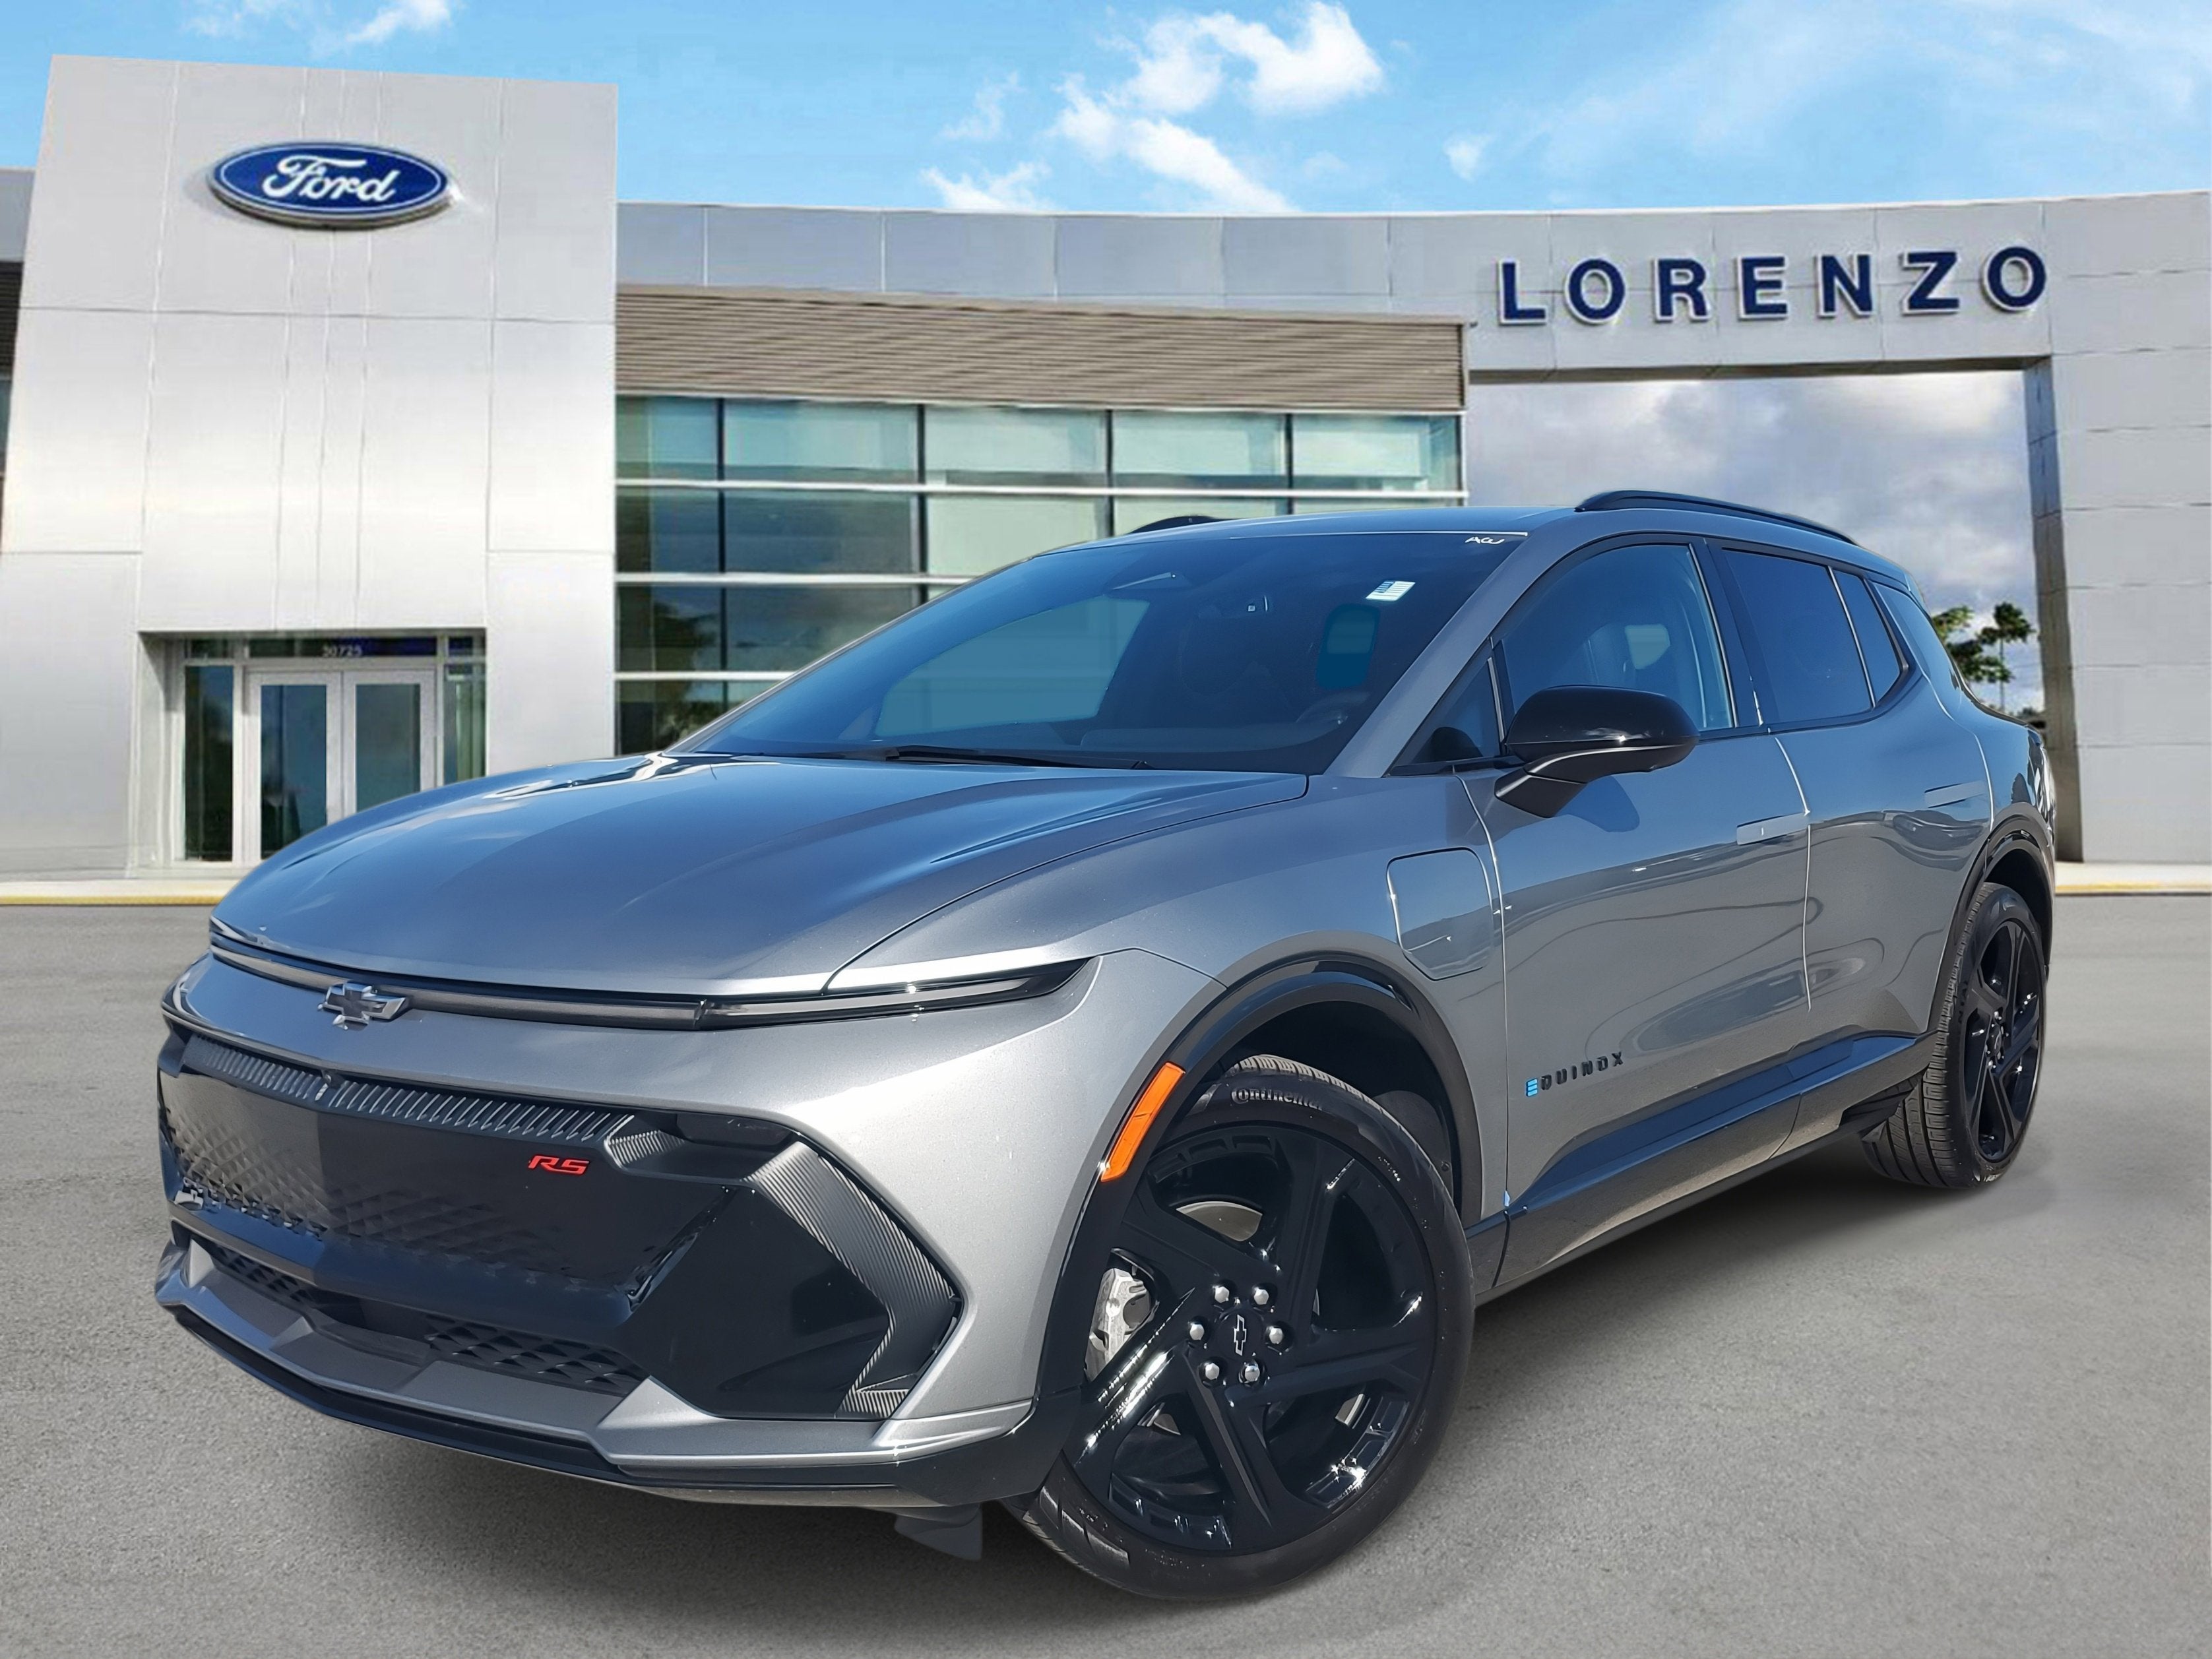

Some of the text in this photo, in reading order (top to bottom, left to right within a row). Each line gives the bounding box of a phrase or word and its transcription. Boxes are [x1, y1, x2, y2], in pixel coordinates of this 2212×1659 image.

[263, 154, 400, 202] Ford
[1499, 246, 2048, 326] LORENZO
[1525, 1051, 1624, 1097] EQUINOX
[528, 1155, 589, 1175] RS
